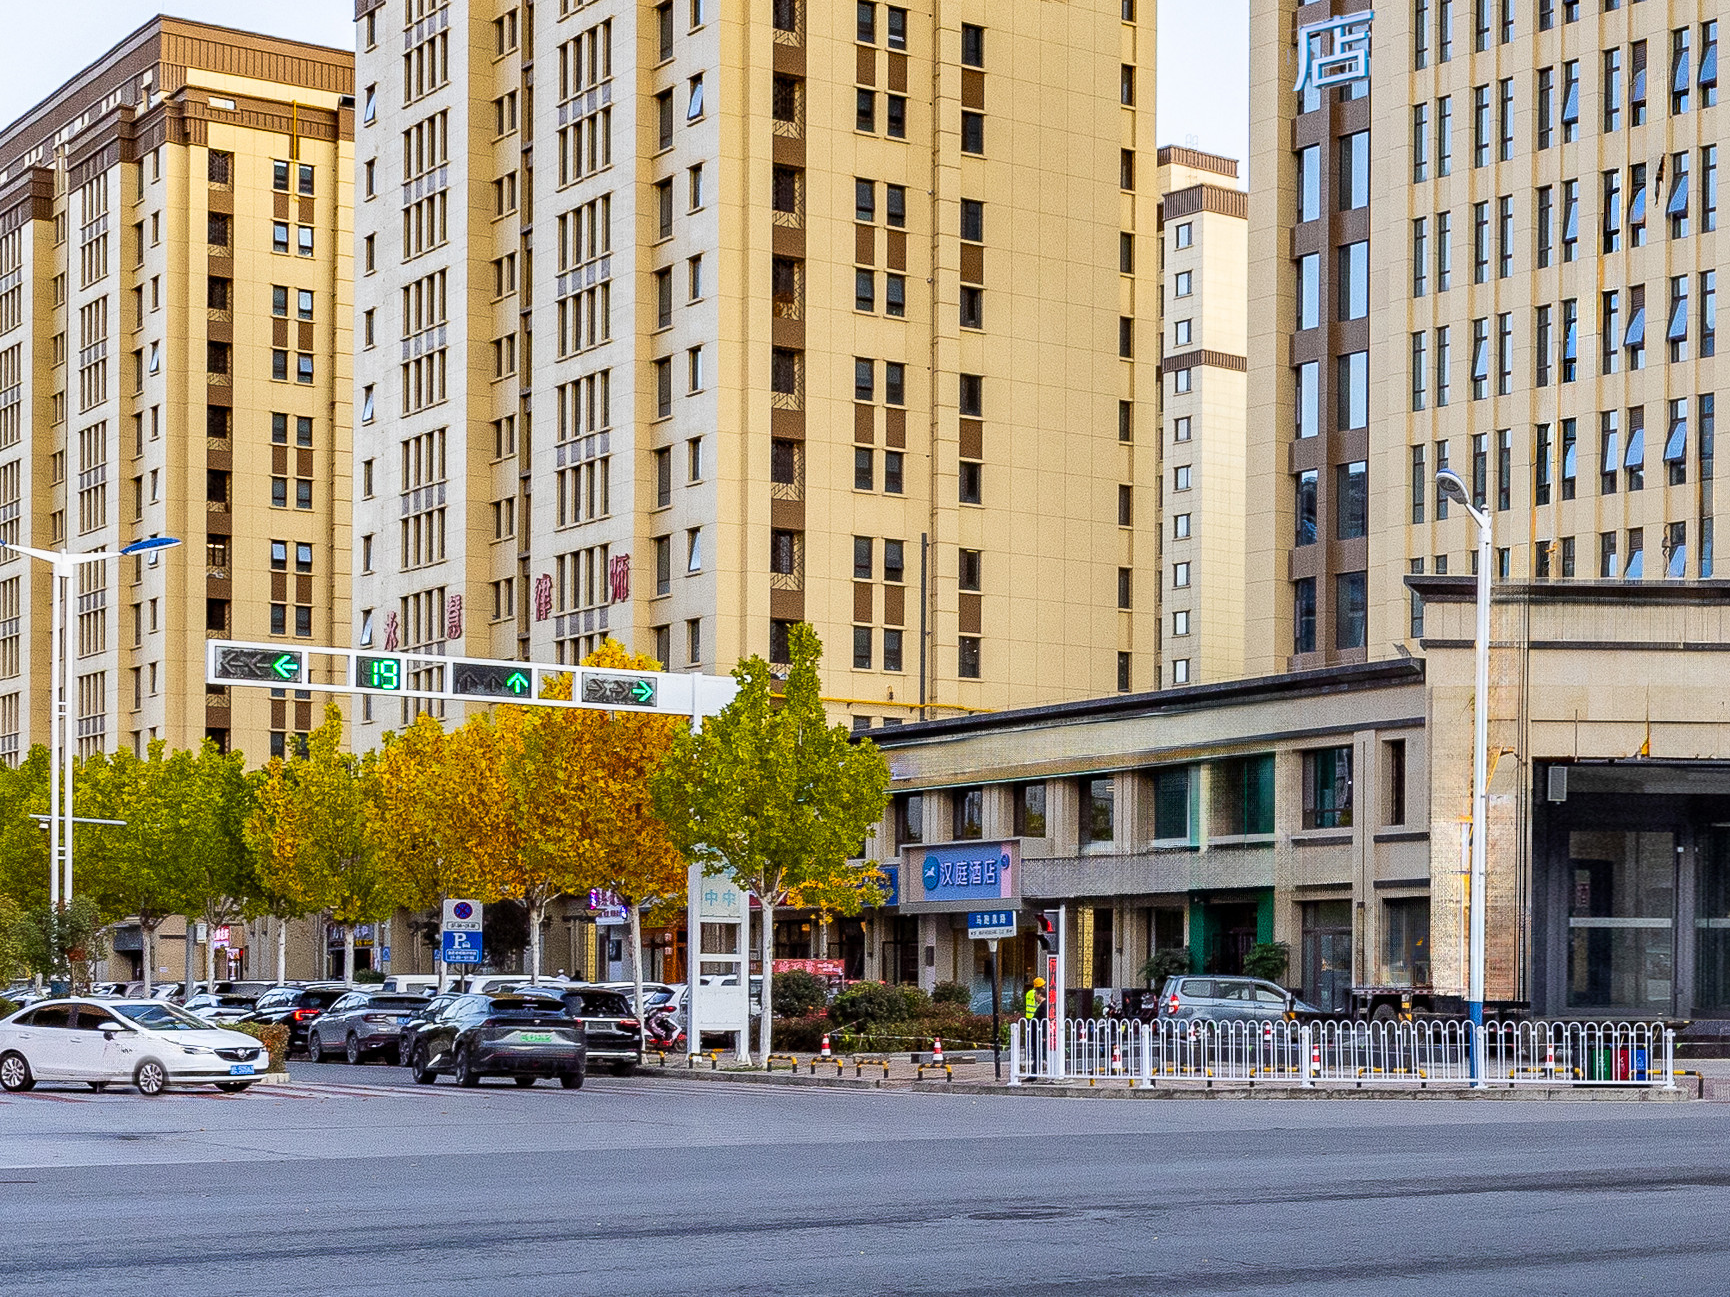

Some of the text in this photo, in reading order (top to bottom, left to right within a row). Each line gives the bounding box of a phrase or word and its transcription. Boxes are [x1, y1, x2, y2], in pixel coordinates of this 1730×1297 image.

[372, 659, 399, 690] 19
[940, 859, 997, 887] 汉庭酒店
[453, 933, 466, 949] P
